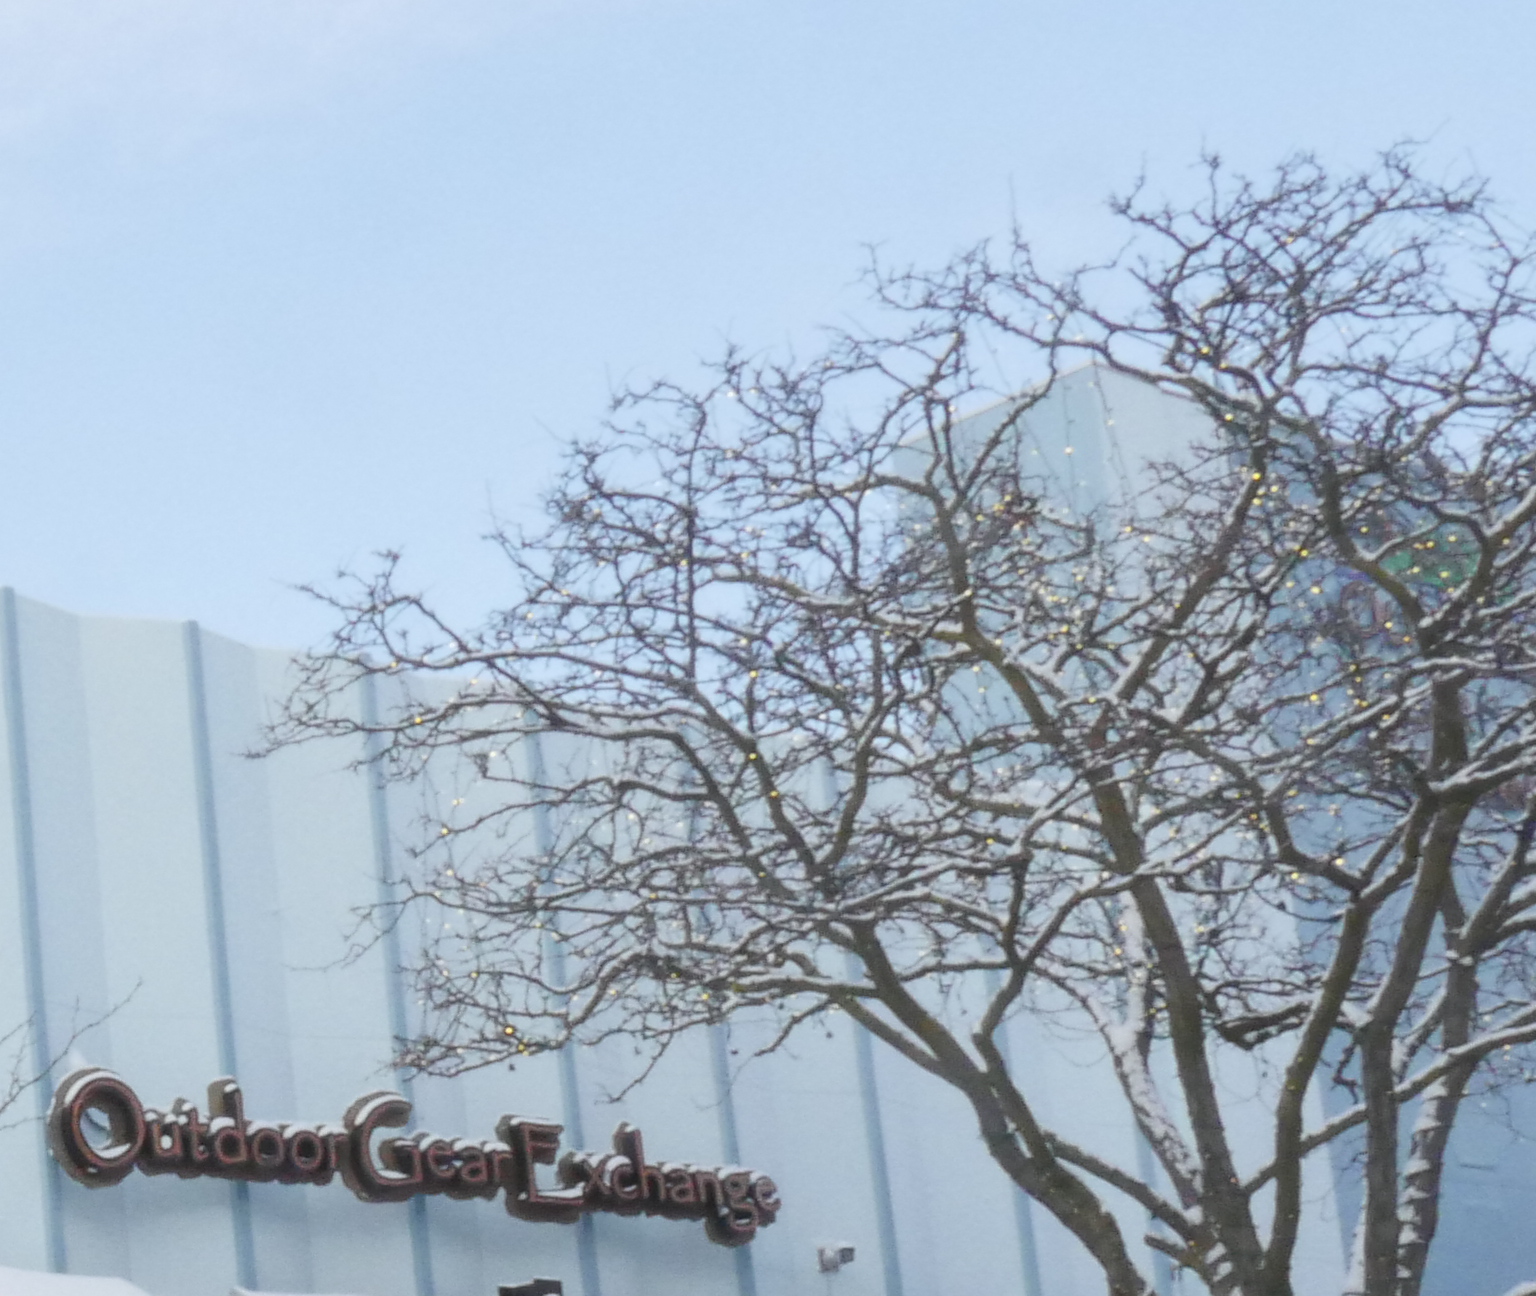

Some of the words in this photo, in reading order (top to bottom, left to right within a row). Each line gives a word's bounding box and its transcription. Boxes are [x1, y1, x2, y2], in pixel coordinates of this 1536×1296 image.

[48, 1069, 347, 1188] Outdoor
[343, 1091, 510, 1203] Gear
[495, 1114, 782, 1248] Exchange
